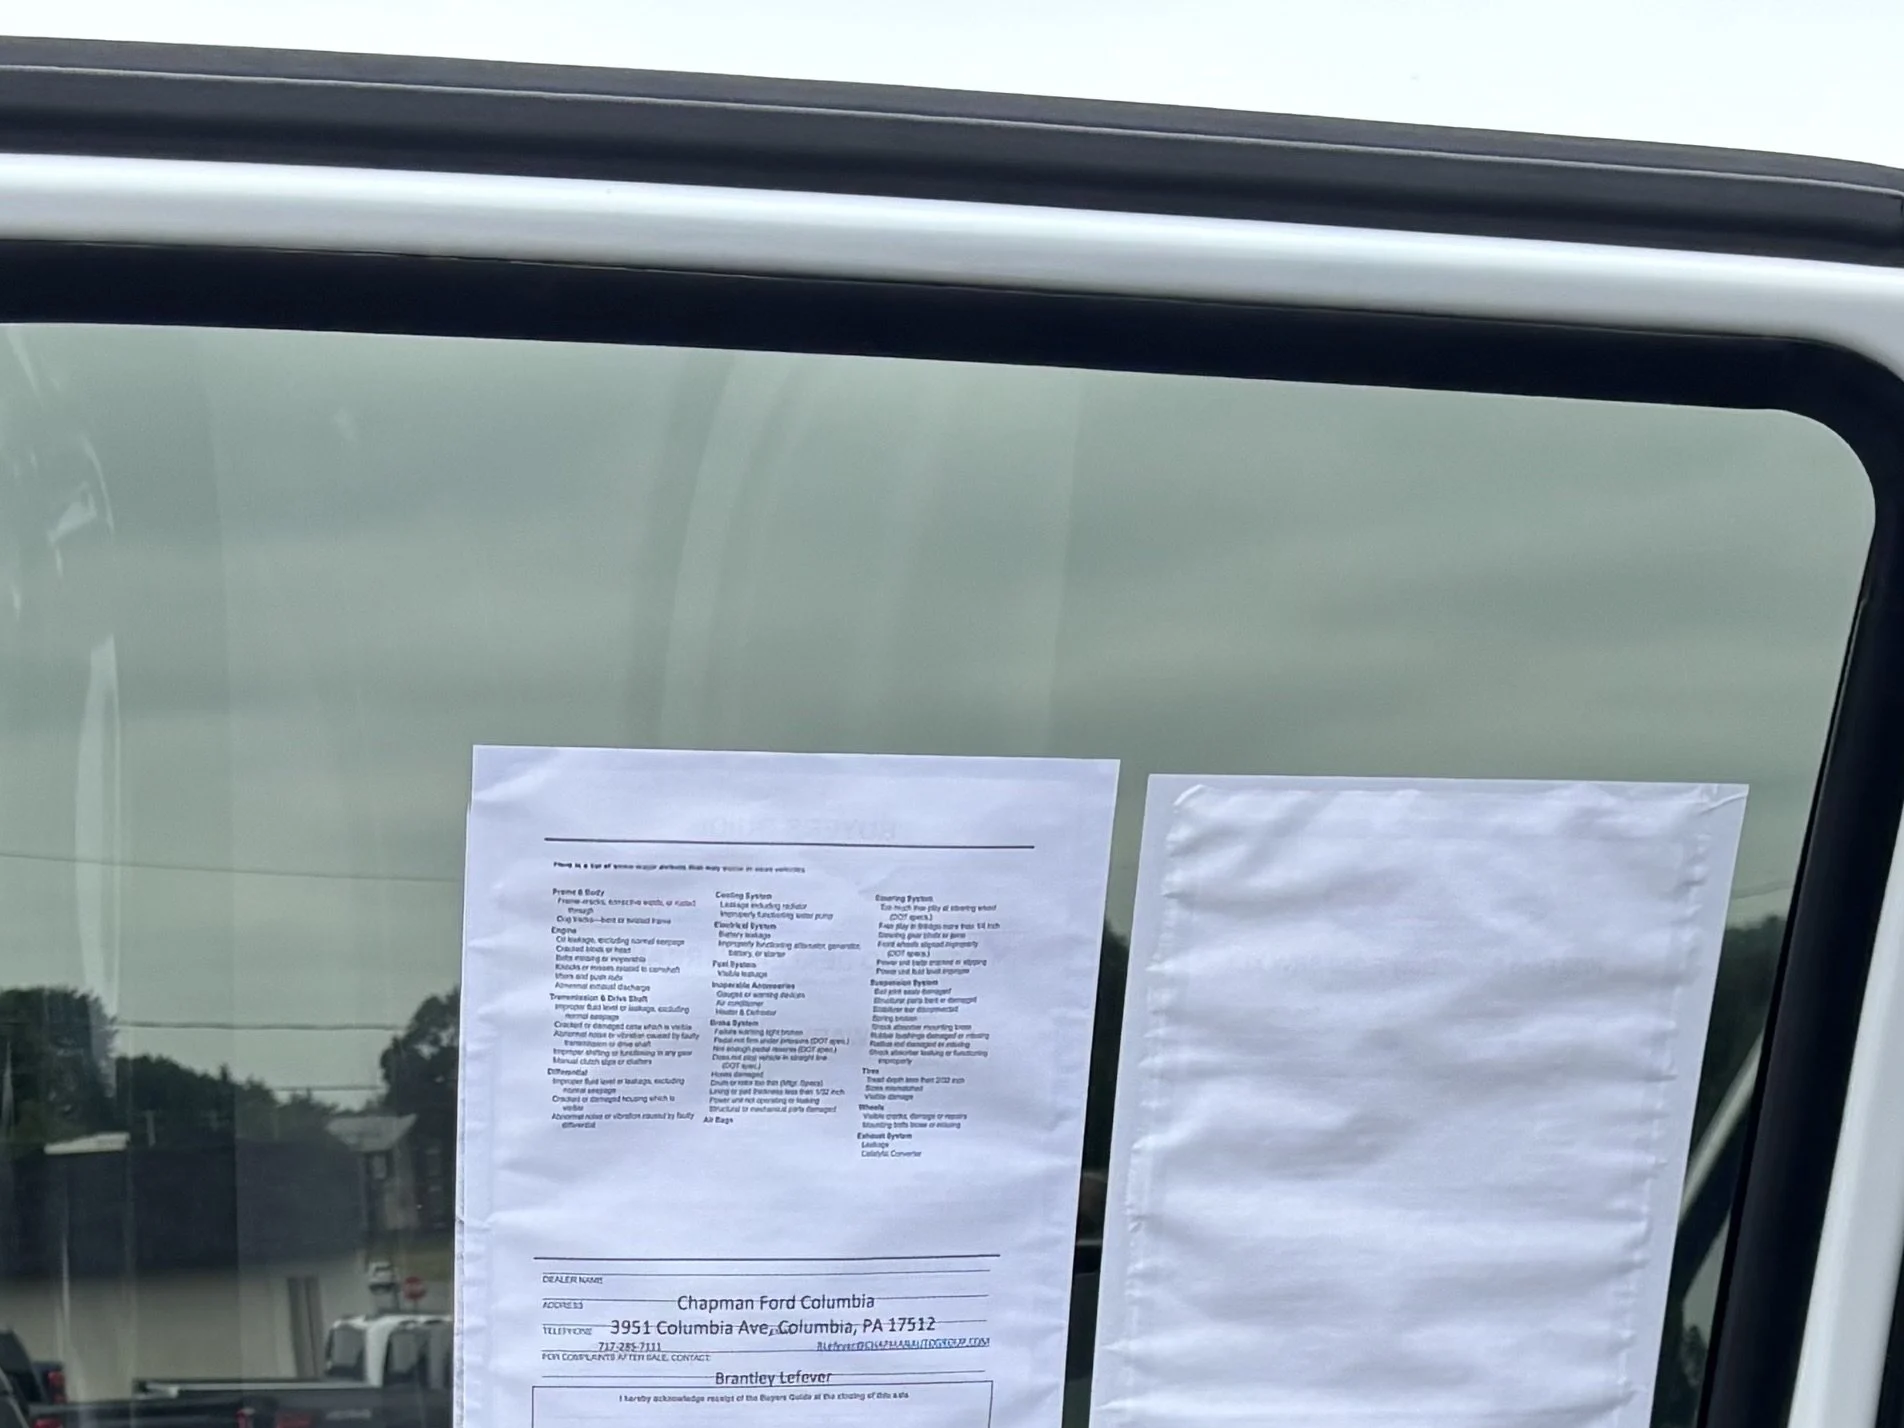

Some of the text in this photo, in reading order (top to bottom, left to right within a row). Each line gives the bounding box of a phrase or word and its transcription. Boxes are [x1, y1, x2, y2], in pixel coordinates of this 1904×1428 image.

[542, 1276, 577, 1284] DEALER
[677, 1293, 875, 1313] Chapman Ford Columbia
[610, 1320, 650, 1335] 3951
[657, 1320, 733, 1335] Columbia
[779, 1317, 857, 1337] Columbia,
[863, 1317, 883, 1332] PA
[889, 1316, 936, 1332] 17512
[598, 1342, 661, 1351] 717-285-7111
[715, 1370, 832, 1387] Brantley Lefever
